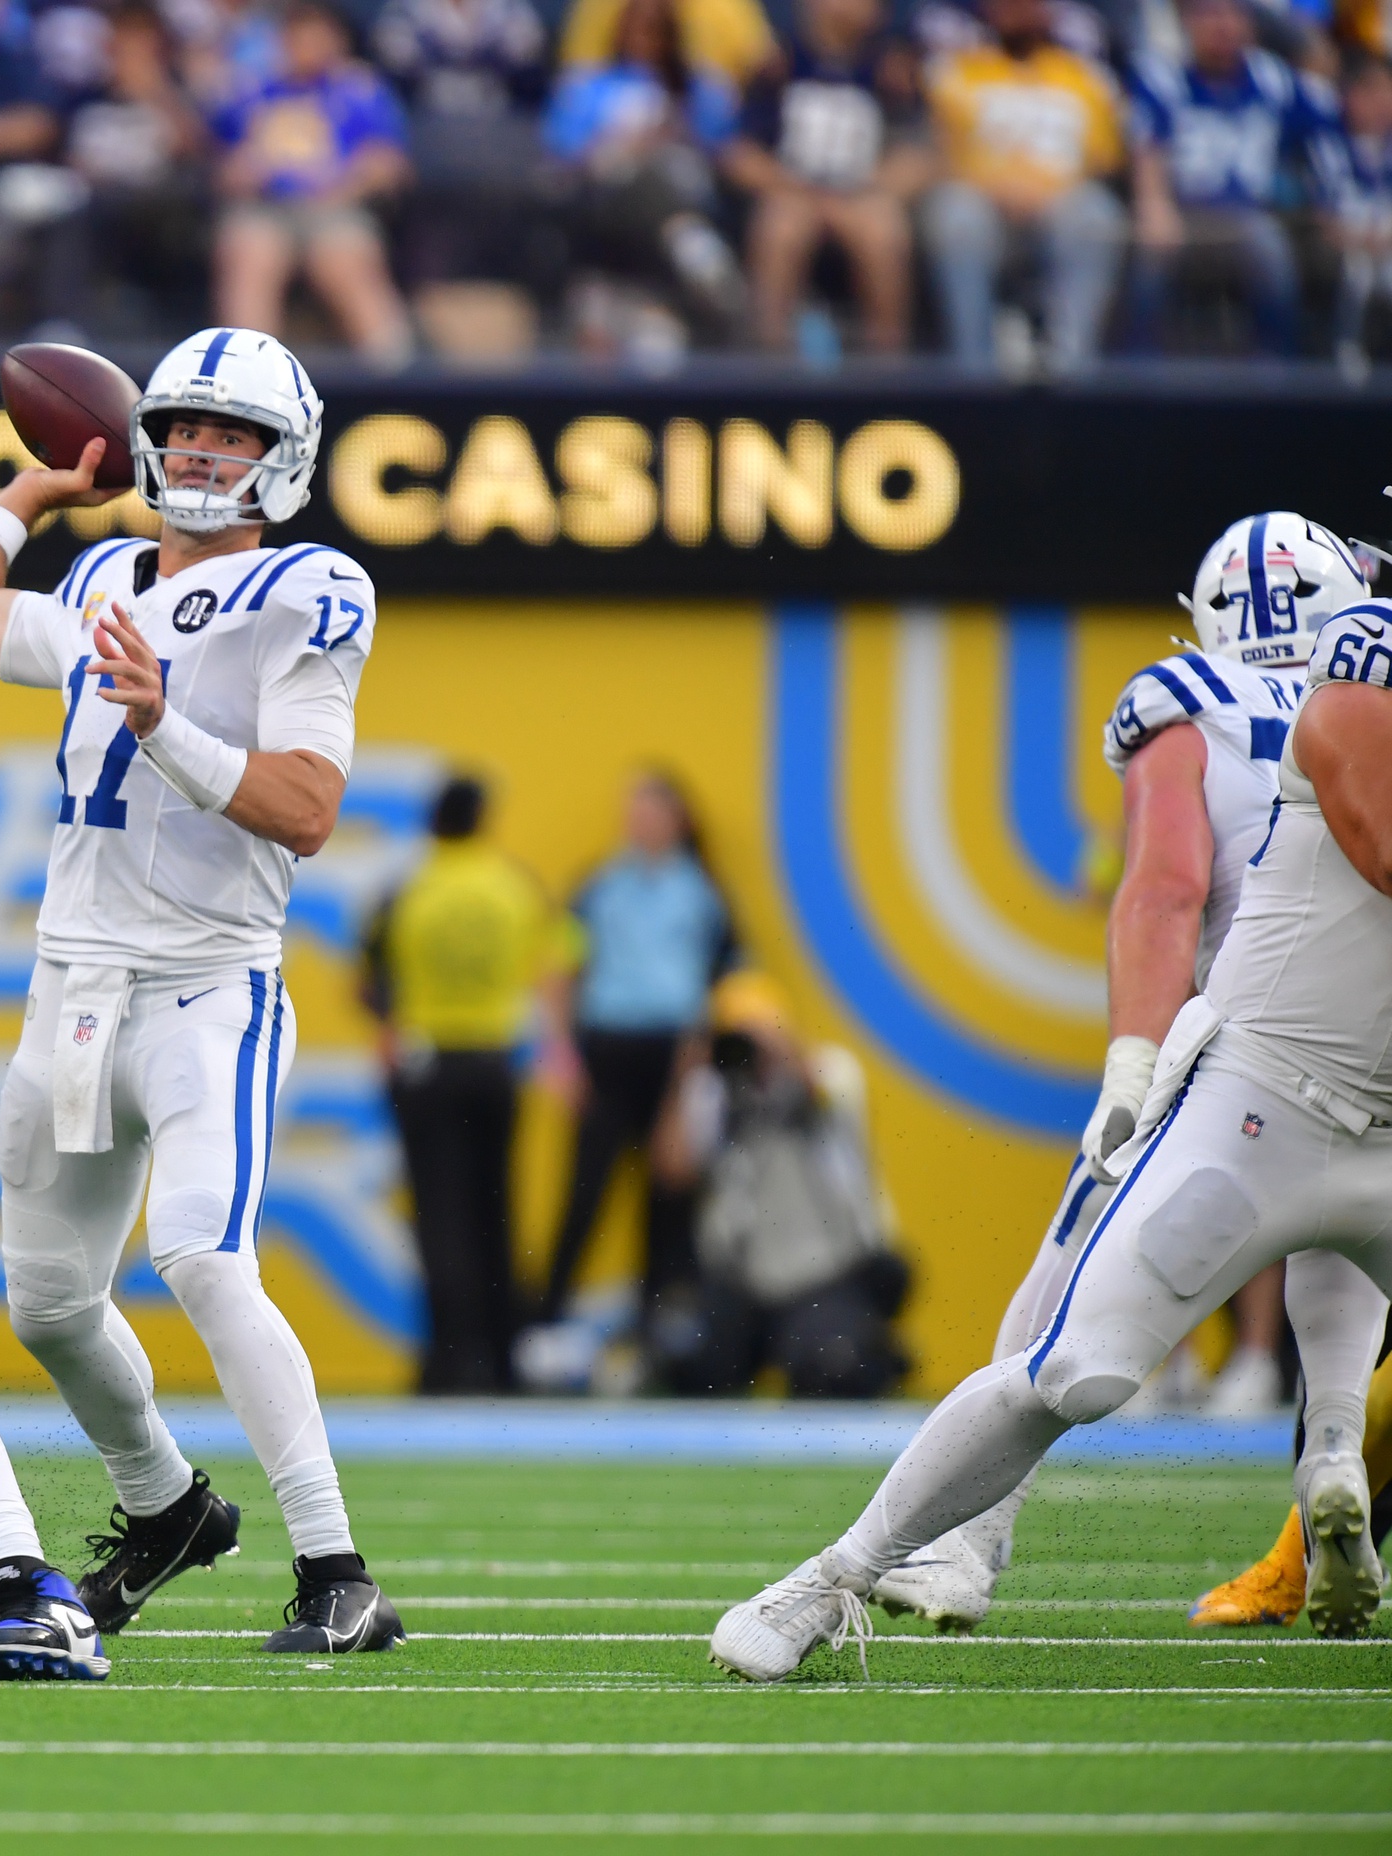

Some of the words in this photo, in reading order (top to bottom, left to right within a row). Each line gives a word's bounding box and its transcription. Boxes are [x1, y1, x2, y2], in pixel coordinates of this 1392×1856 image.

[327, 414, 960, 551] CASINO
[308, 595, 364, 651] 17
[1229, 585, 1298, 641] 79
[1242, 643, 1295, 664] COLTS
[56, 655, 172, 830] 17
